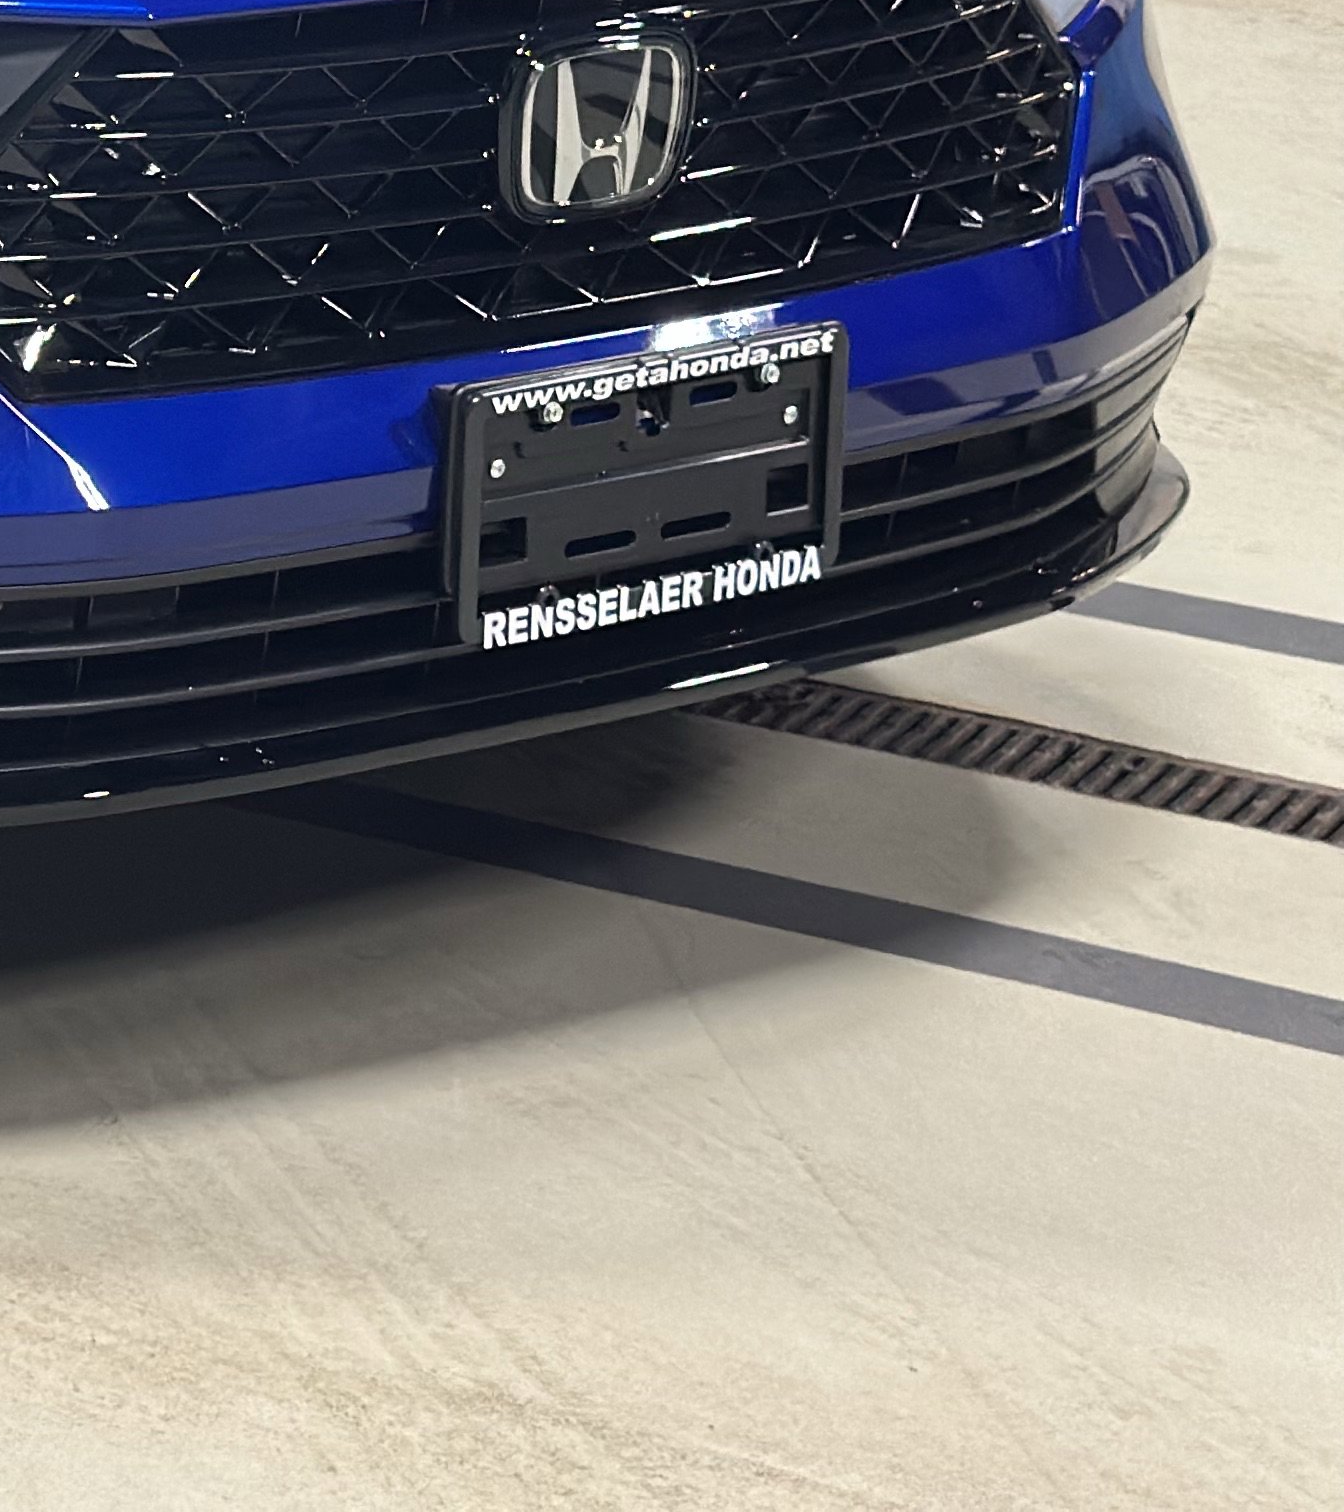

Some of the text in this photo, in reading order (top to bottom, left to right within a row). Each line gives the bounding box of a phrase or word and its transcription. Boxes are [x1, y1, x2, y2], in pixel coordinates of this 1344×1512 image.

[491, 333, 835, 415] www.getahonda.net
[482, 543, 822, 651] RENSSELAER HONDA
